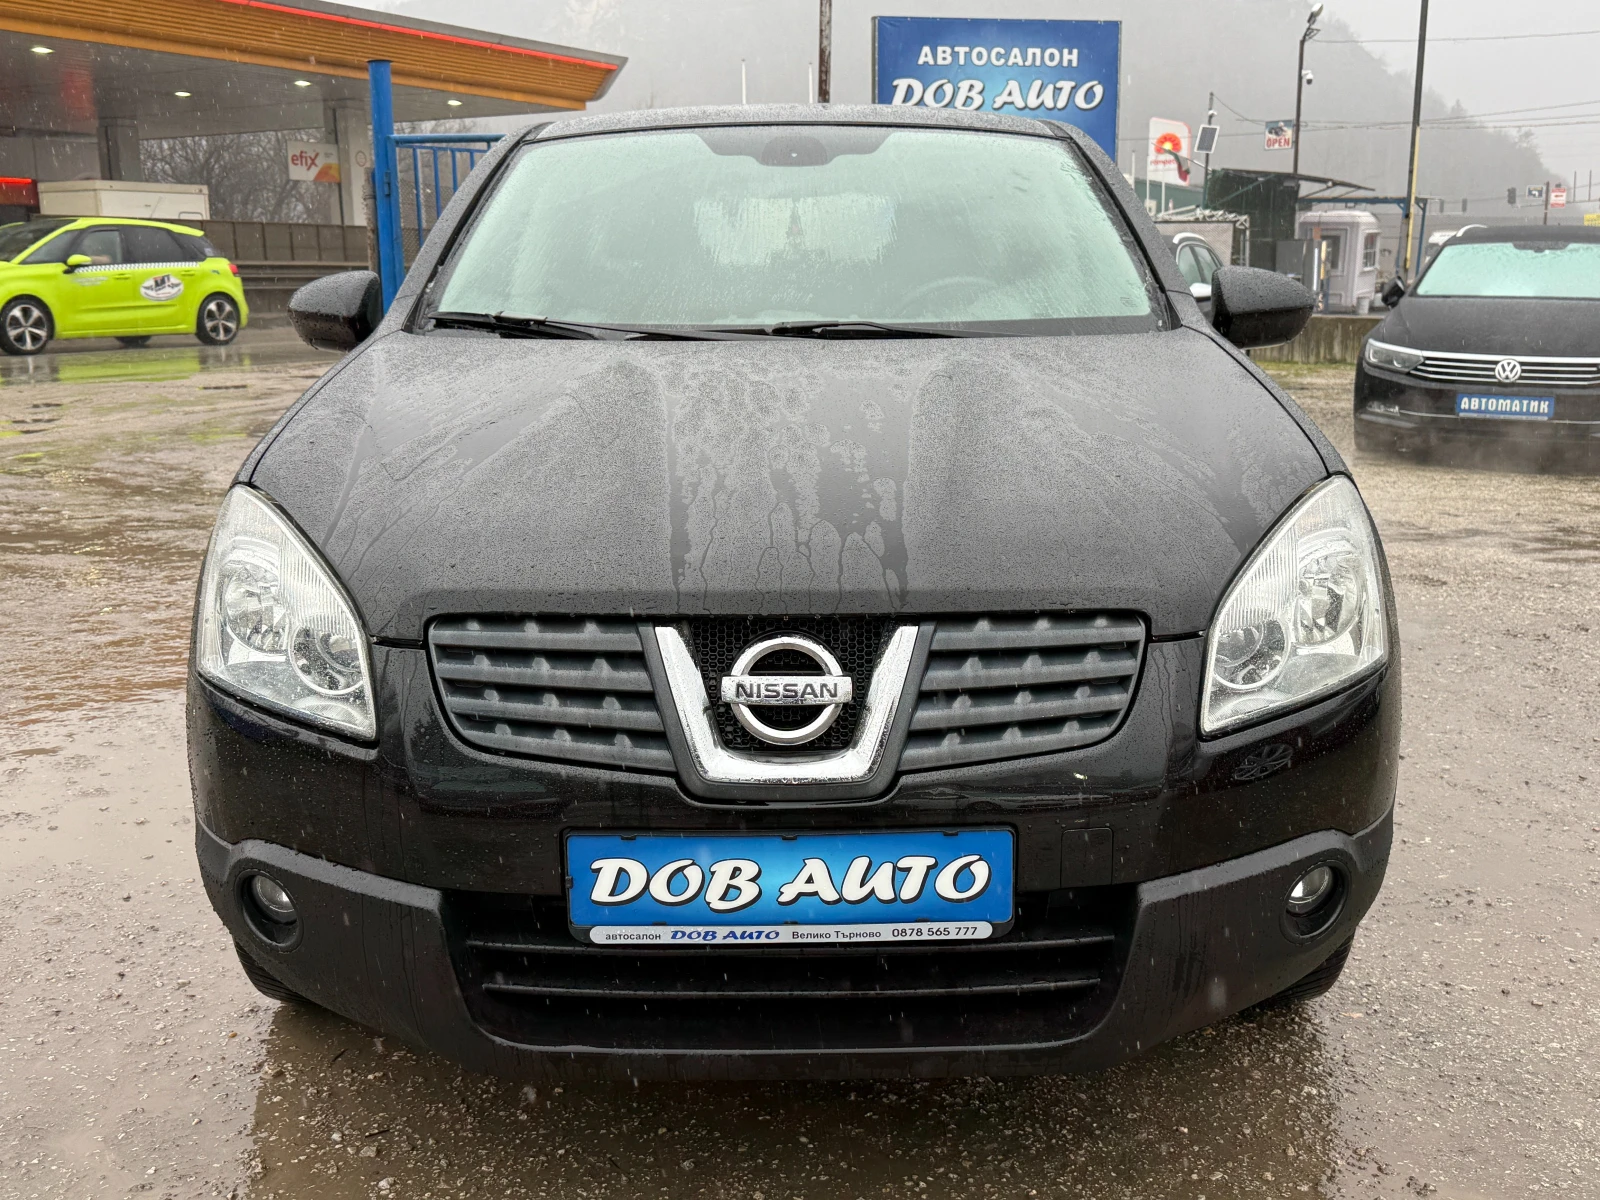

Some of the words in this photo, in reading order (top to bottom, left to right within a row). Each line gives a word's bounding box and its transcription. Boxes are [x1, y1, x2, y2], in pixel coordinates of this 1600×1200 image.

[917, 45, 1079, 68] АВТОСАЛОН
[891, 78, 984, 111] DOB
[992, 79, 1105, 111] AUTO
[1266, 137, 1290, 148] OPEN
[291, 150, 319, 171] efix
[1460, 396, 1550, 414] АВТОМАТИК
[735, 682, 838, 699] NISSAN
[589, 857, 762, 914] DOB
[776, 854, 992, 907] AUTO
[605, 932, 662, 941] автосалон
[670, 930, 718, 942] DOB
[721, 930, 780, 940] AUTO
[791, 930, 832, 940] Велико
[833, 930, 882, 940] Търново
[891, 927, 924, 937] 0878
[927, 927, 951, 937] 565
[954, 926, 978, 936] 777
